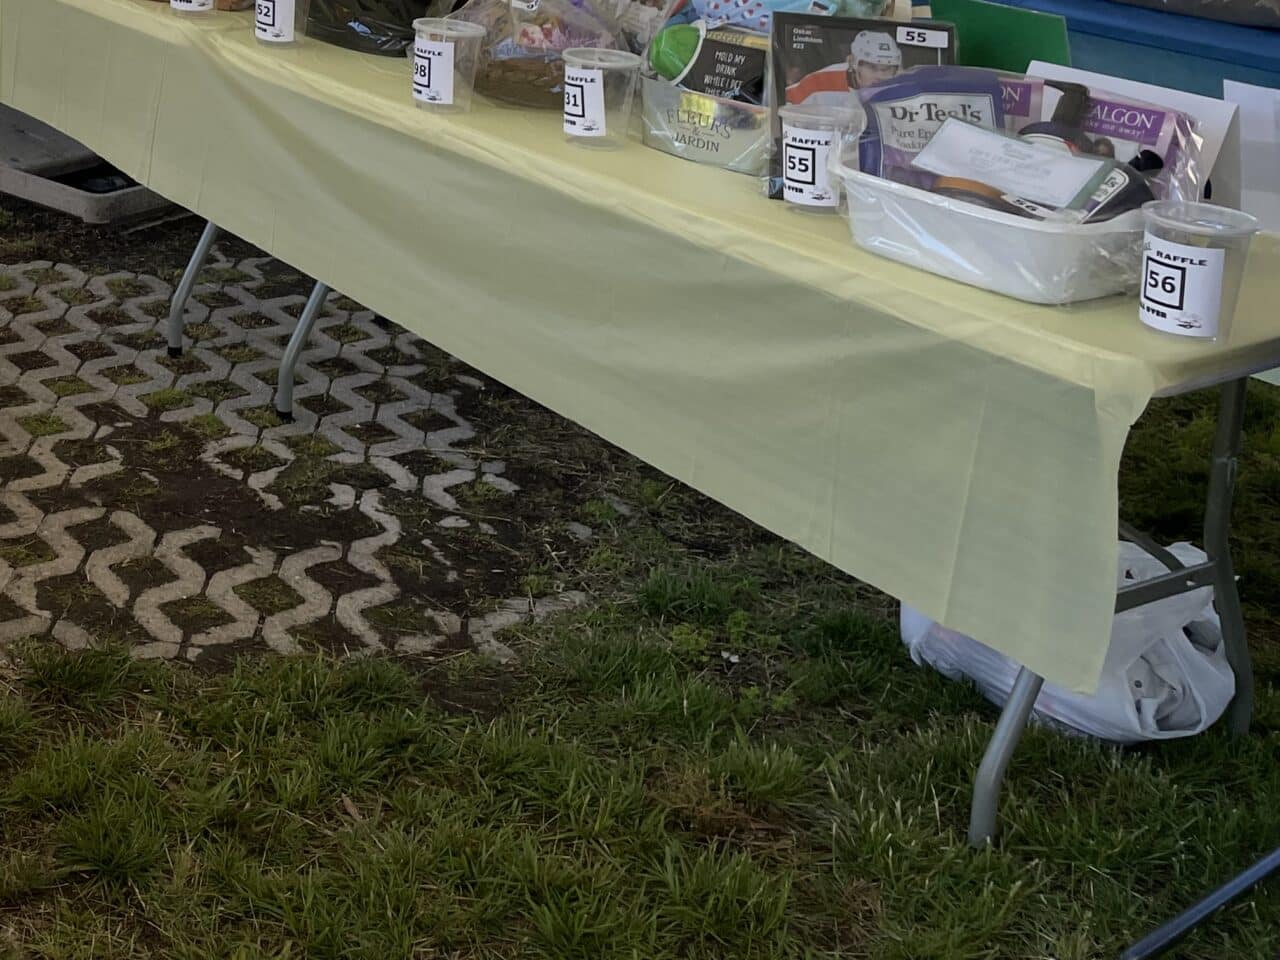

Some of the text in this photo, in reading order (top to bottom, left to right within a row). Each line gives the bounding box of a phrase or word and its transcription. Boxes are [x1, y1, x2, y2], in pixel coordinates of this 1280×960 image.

[257, 4, 271, 18] 52
[905, 31, 927, 43] 55
[715, 64, 737, 76] DRINK
[568, 75, 597, 83] RAFFLE
[565, 91, 580, 107] 31
[890, 106, 920, 122] Dr
[667, 110, 733, 139] FLEURS
[1118, 126, 1145, 138] away!
[671, 133, 720, 153] JARDIN
[791, 136, 832, 146] RAFFLE
[787, 155, 810, 173] 55
[1013, 198, 1038, 212] 56
[1156, 250, 1208, 266] RAFFLE
[1148, 269, 1176, 294] 56
